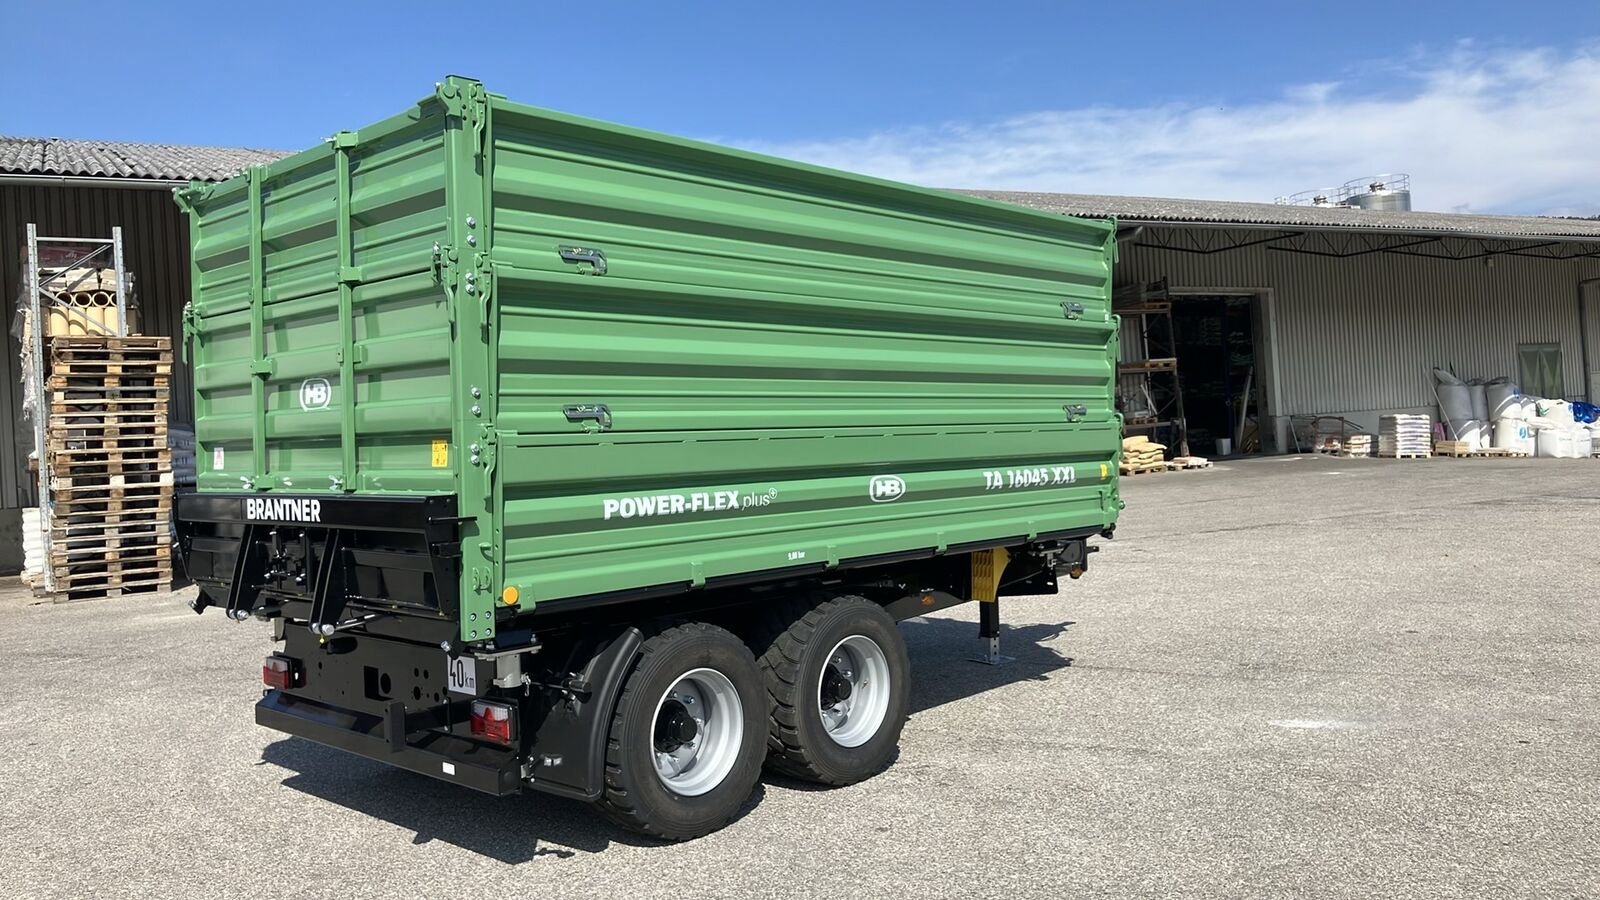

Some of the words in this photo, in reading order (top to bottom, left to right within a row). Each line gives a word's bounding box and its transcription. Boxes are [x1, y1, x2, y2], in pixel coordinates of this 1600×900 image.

[983, 471, 1003, 490] TA
[1007, 467, 1049, 488] 16045
[246, 498, 321, 522] BRANTNER
[603, 490, 740, 520] POWER-FLEX
[741, 492, 770, 511] plus
[450, 659, 464, 688] 40
[464, 672, 475, 689] km
